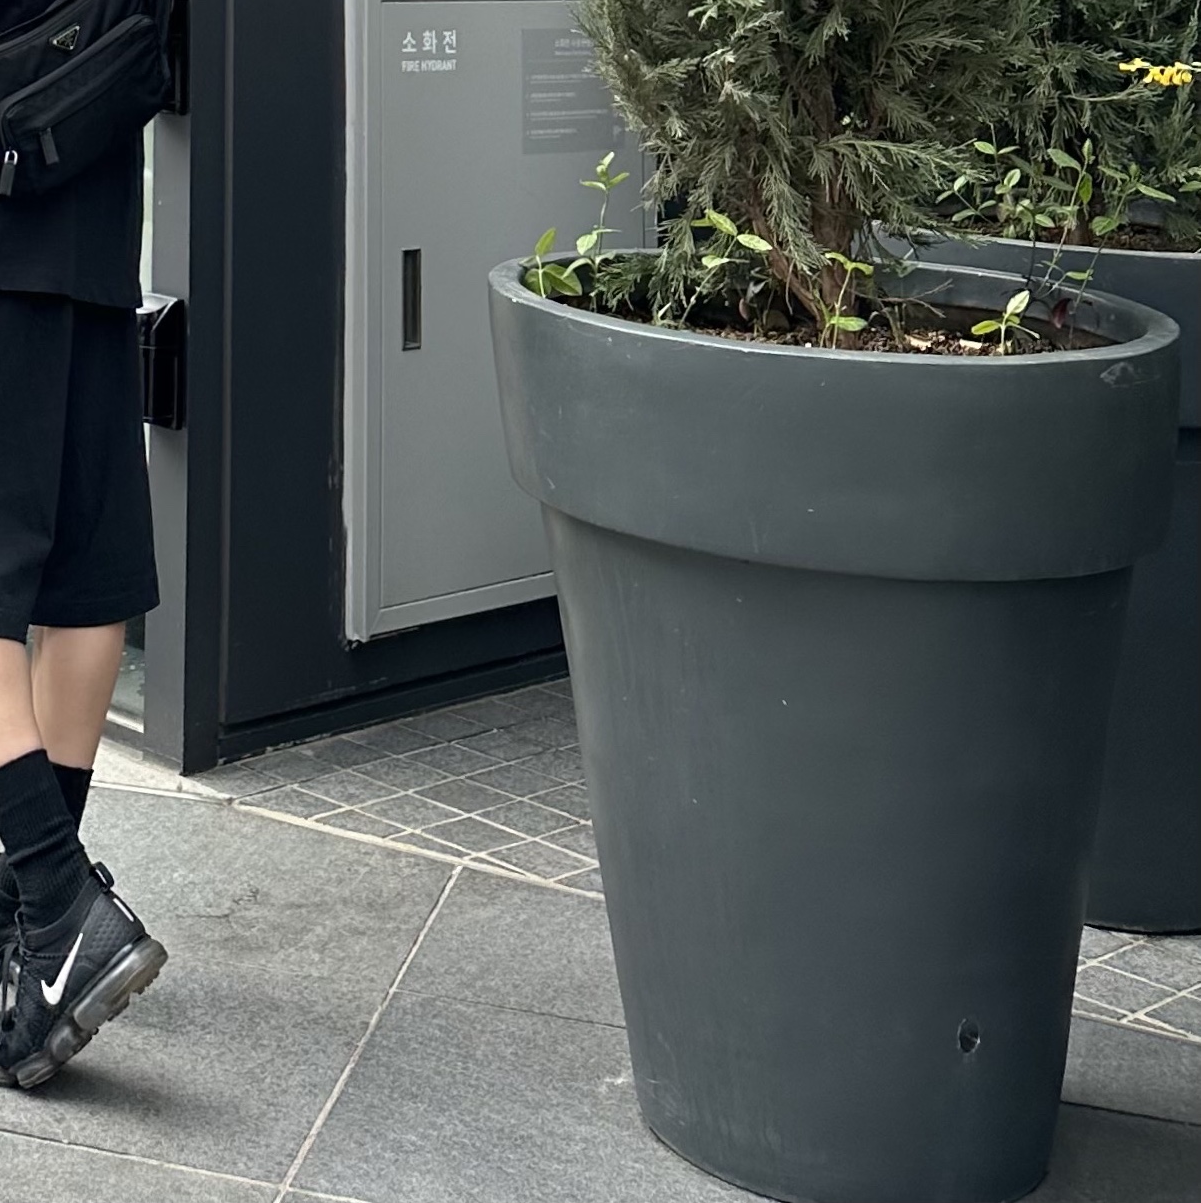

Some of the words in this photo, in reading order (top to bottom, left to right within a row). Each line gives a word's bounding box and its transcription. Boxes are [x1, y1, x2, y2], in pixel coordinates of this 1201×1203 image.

[401, 29, 457, 54] 소화전
[401, 60, 420, 73] FIRE
[420, 59, 457, 72] HYDRANT
